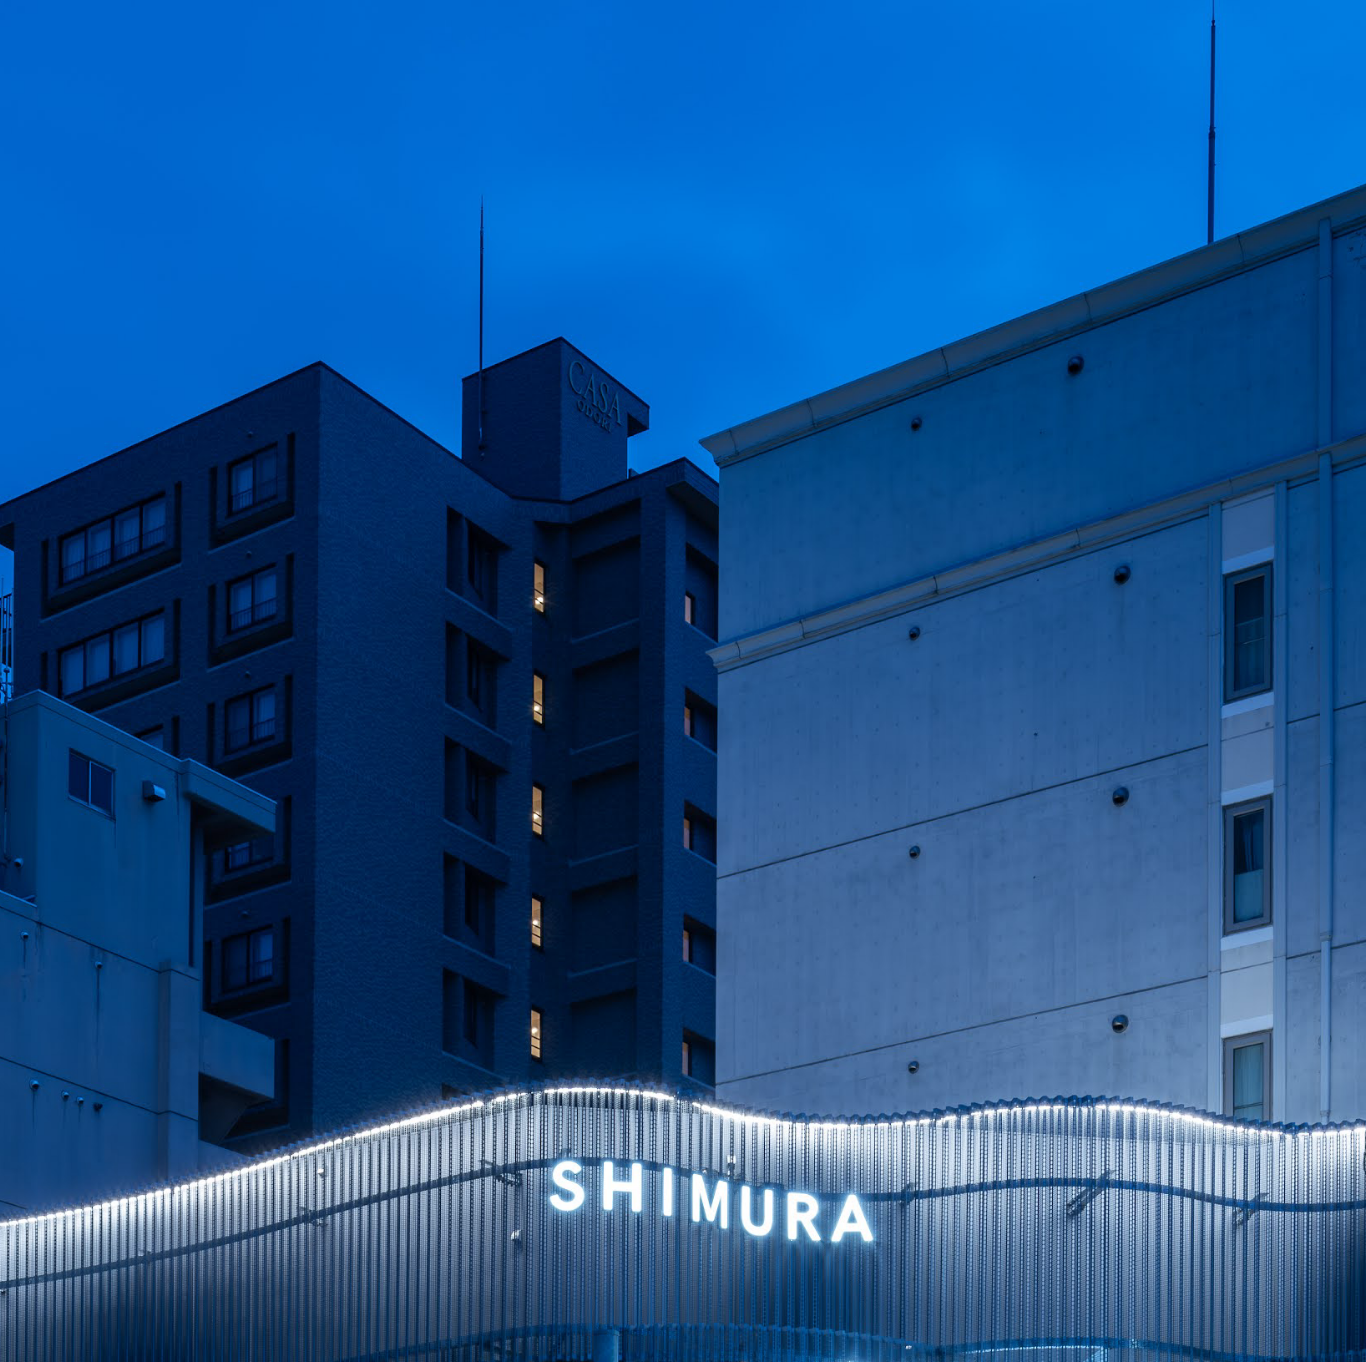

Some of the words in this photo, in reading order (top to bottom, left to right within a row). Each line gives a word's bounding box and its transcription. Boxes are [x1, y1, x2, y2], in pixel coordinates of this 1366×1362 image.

[569, 360, 622, 426] CASA
[577, 399, 612, 434] ODORI
[548, 1160, 874, 1243] SHIMURA
